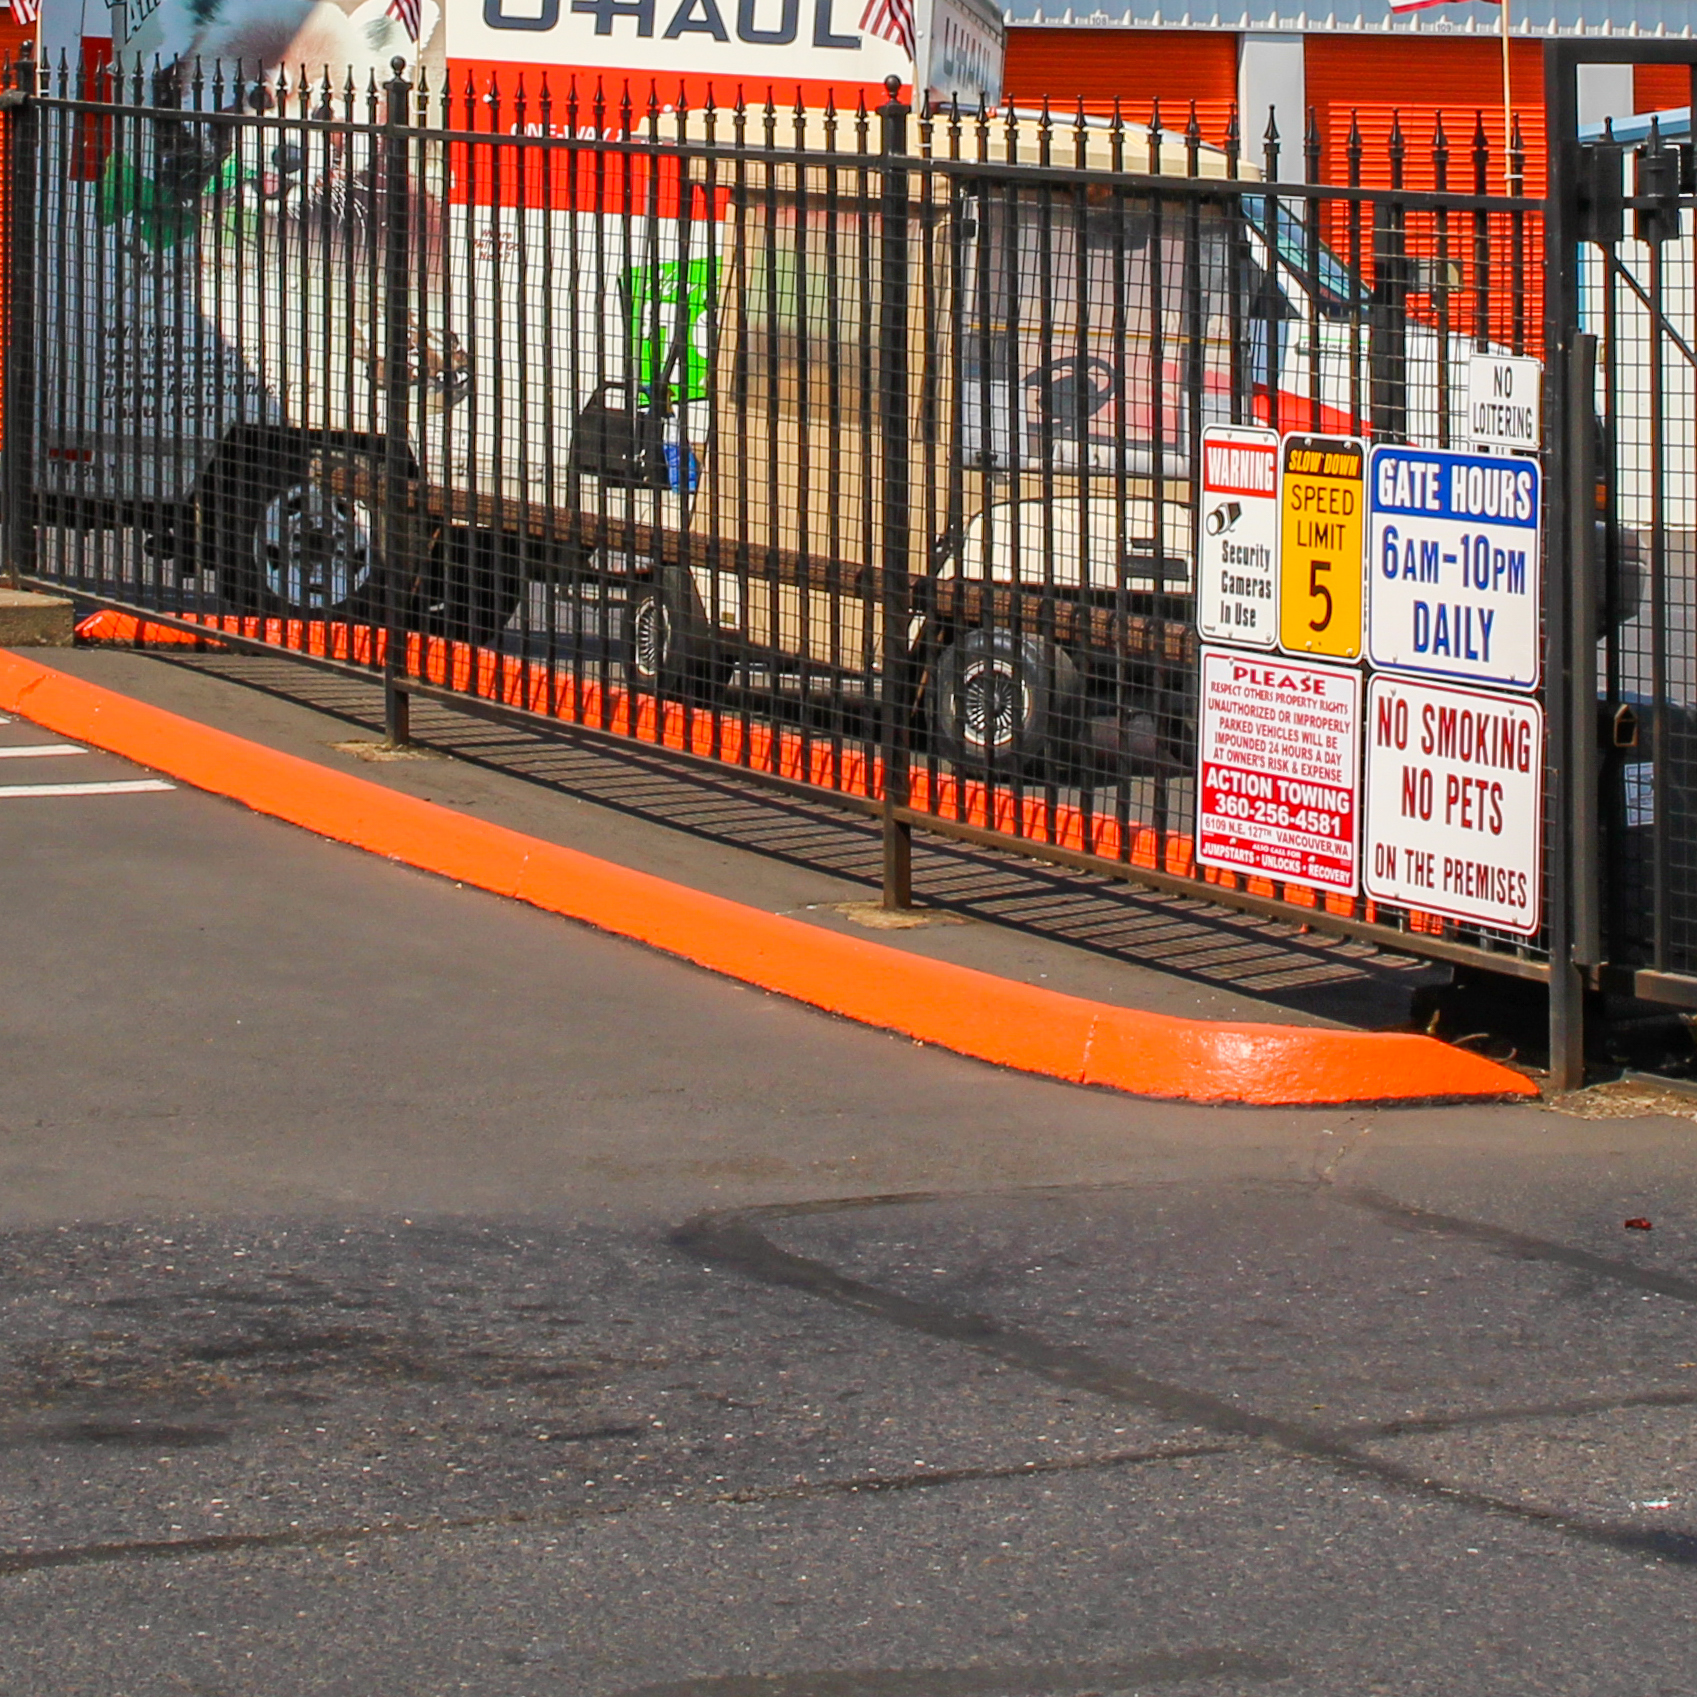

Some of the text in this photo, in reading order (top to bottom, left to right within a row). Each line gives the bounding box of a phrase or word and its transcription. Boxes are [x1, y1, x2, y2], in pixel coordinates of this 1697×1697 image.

[1493, 365, 1514, 399] NO
[1472, 401, 1533, 440] LOITERING
[1206, 446, 1275, 492] WARNING
[1288, 449, 1359, 477] SLOW DOWN
[1290, 484, 1355, 516] SPEED
[1377, 457, 1533, 522] GATE HOURS
[1296, 519, 1347, 552] LIMIT
[1221, 539, 1271, 573] Security
[1220, 570, 1272, 600] Cameras
[1308, 559, 1333, 632] 5
[1219, 600, 1257, 628] In Use
[1412, 598, 1495, 664] DAILY
[1210, 681, 1349, 715] RESPECT OTHERS PROPERTY RIGHTS
[1232, 665, 1327, 697] PLEASE
[1207, 697, 1351, 735] UNAUTHORIZED OR IMPROPERLY
[1219, 716, 1338, 750] PARKED VEHICLES WILL BE
[1214, 731, 1343, 766] IMPOUNDED 24 HOURS A DAY
[1376, 695, 1531, 774] NO SMOKING
[1212, 747, 1343, 783] AT OWNER'S RISK & EXPENSE
[1205, 766, 1351, 815] ACTION TOWING
[1400, 764, 1504, 836] NO PETS
[1205, 816, 1227, 830] 6109
[1228, 822, 1246, 836] N.E.
[1214, 792, 1342, 838] 360-256-4581
[1202, 841, 1351, 884] JUMPSTARTS UNLOCKS RECOVERY
[1251, 843, 1302, 859] ALSO CALL FOR
[1374, 841, 1528, 910] ON THE PREMISES
